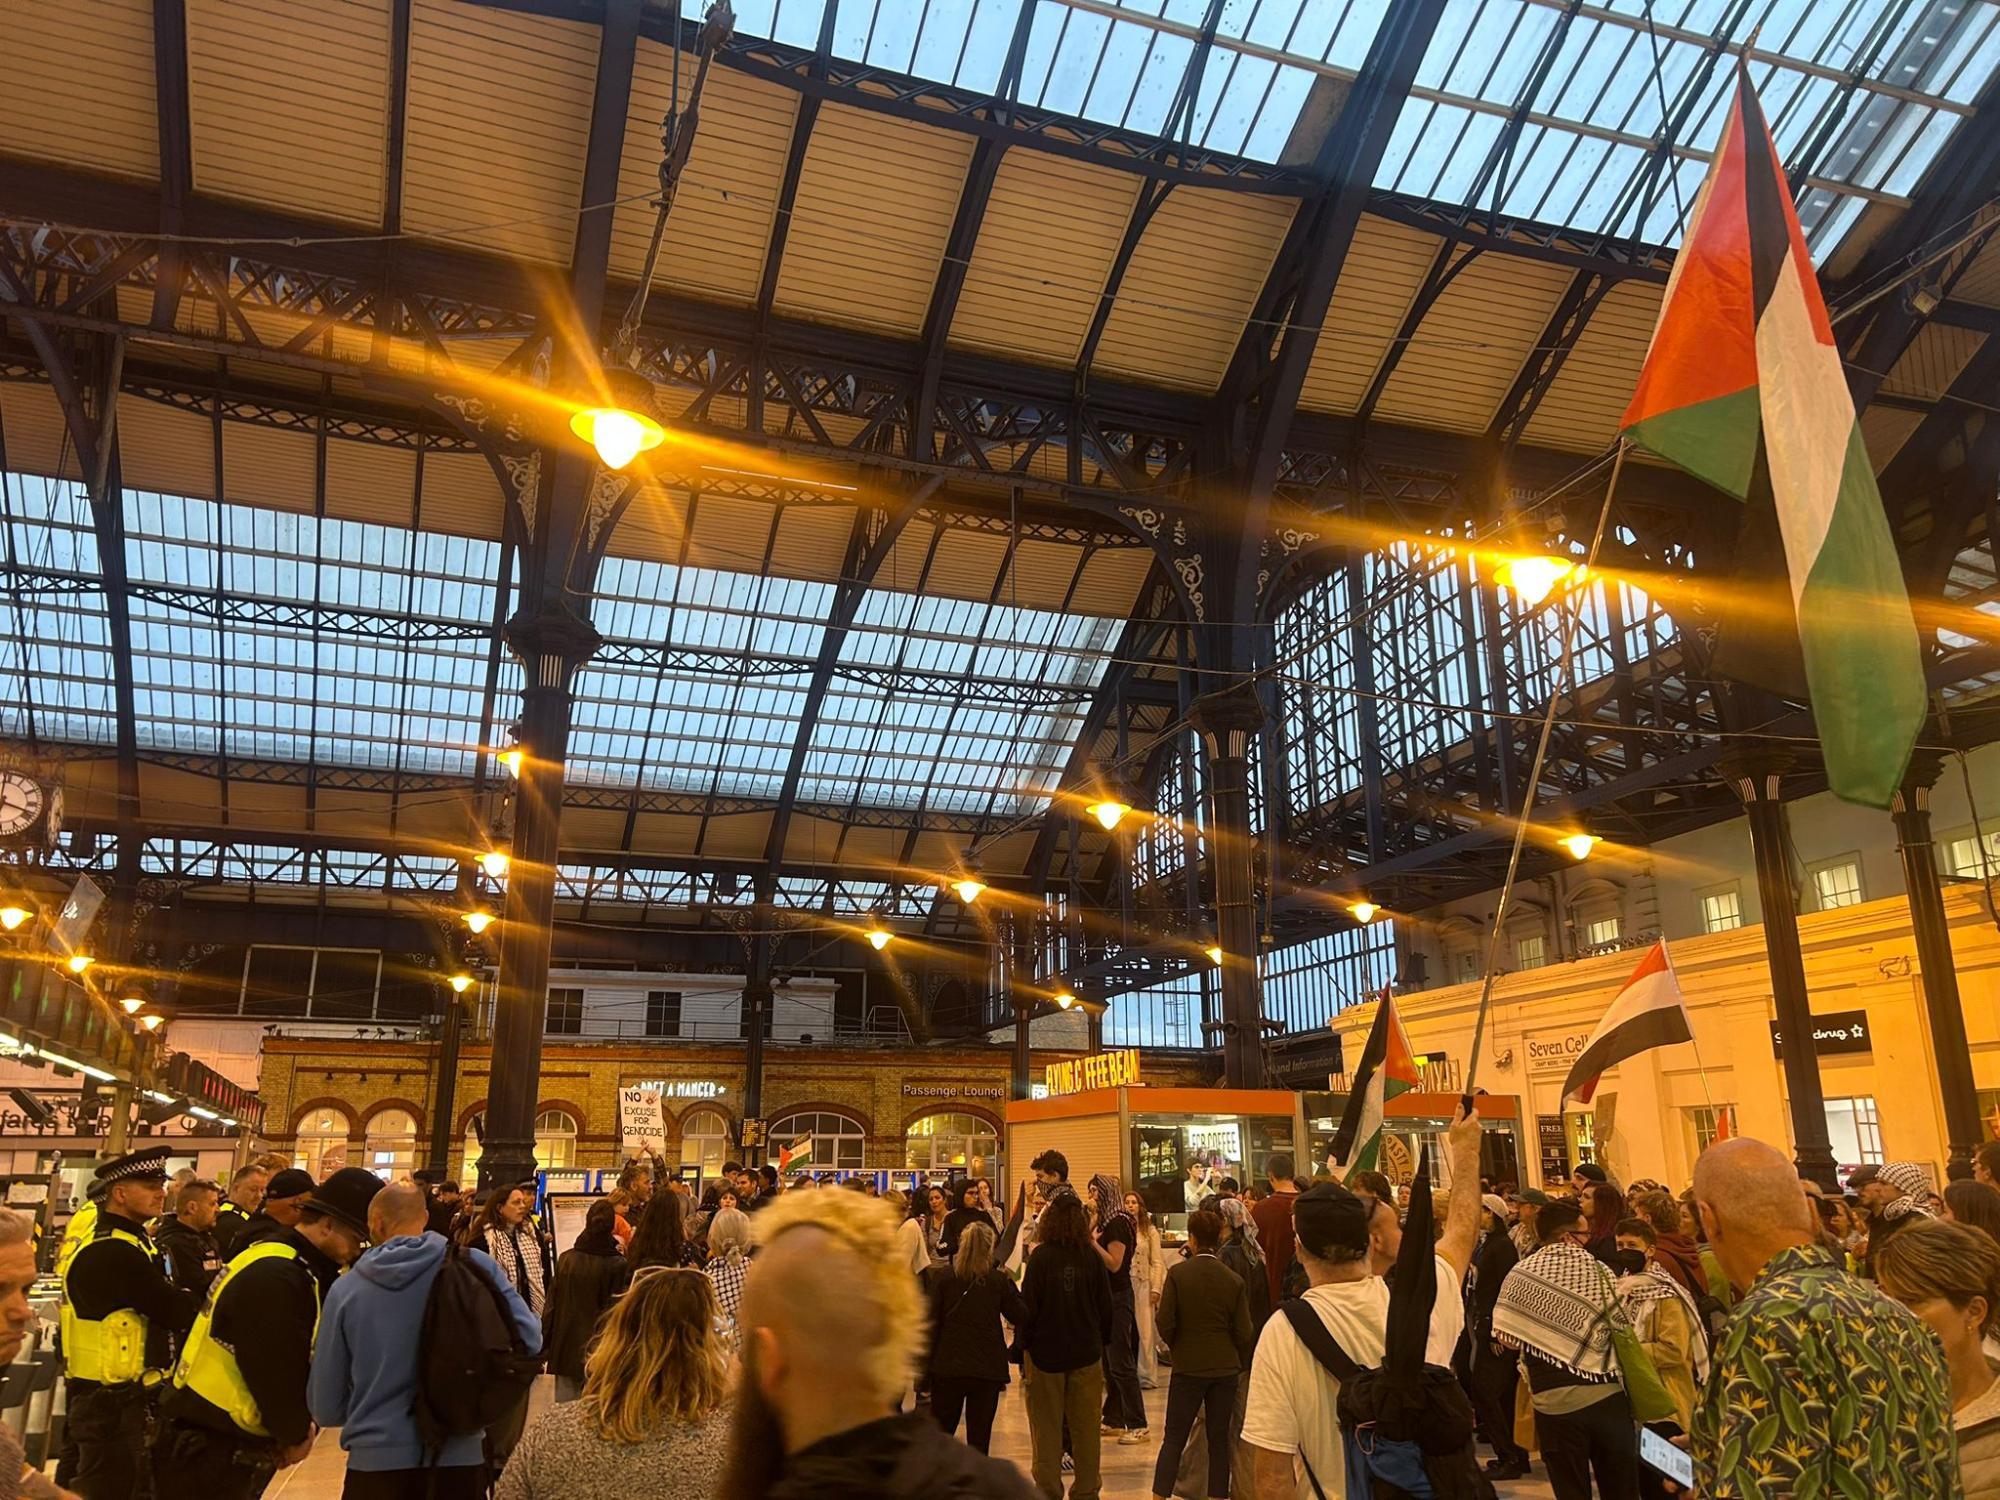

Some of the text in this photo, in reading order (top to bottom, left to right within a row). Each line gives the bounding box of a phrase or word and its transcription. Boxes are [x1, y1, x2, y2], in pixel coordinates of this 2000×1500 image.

[1774, 1029, 1848, 1044] Sdrug
[1529, 1034, 1589, 1058] Seven Cell
[1074, 1054, 1109, 1092] CFFEE
[1108, 1048, 1140, 1087] BEAN
[666, 1081, 674, 1097] A
[903, 1084, 1005, 1099] Passenge Lounge
[624, 1091, 641, 1103] NO
[624, 1106, 658, 1117] EXCUSE
[634, 1117, 650, 1126] FOR
[623, 1126, 663, 1138] GENOCIDE
[1540, 1124, 1563, 1133] FREE
